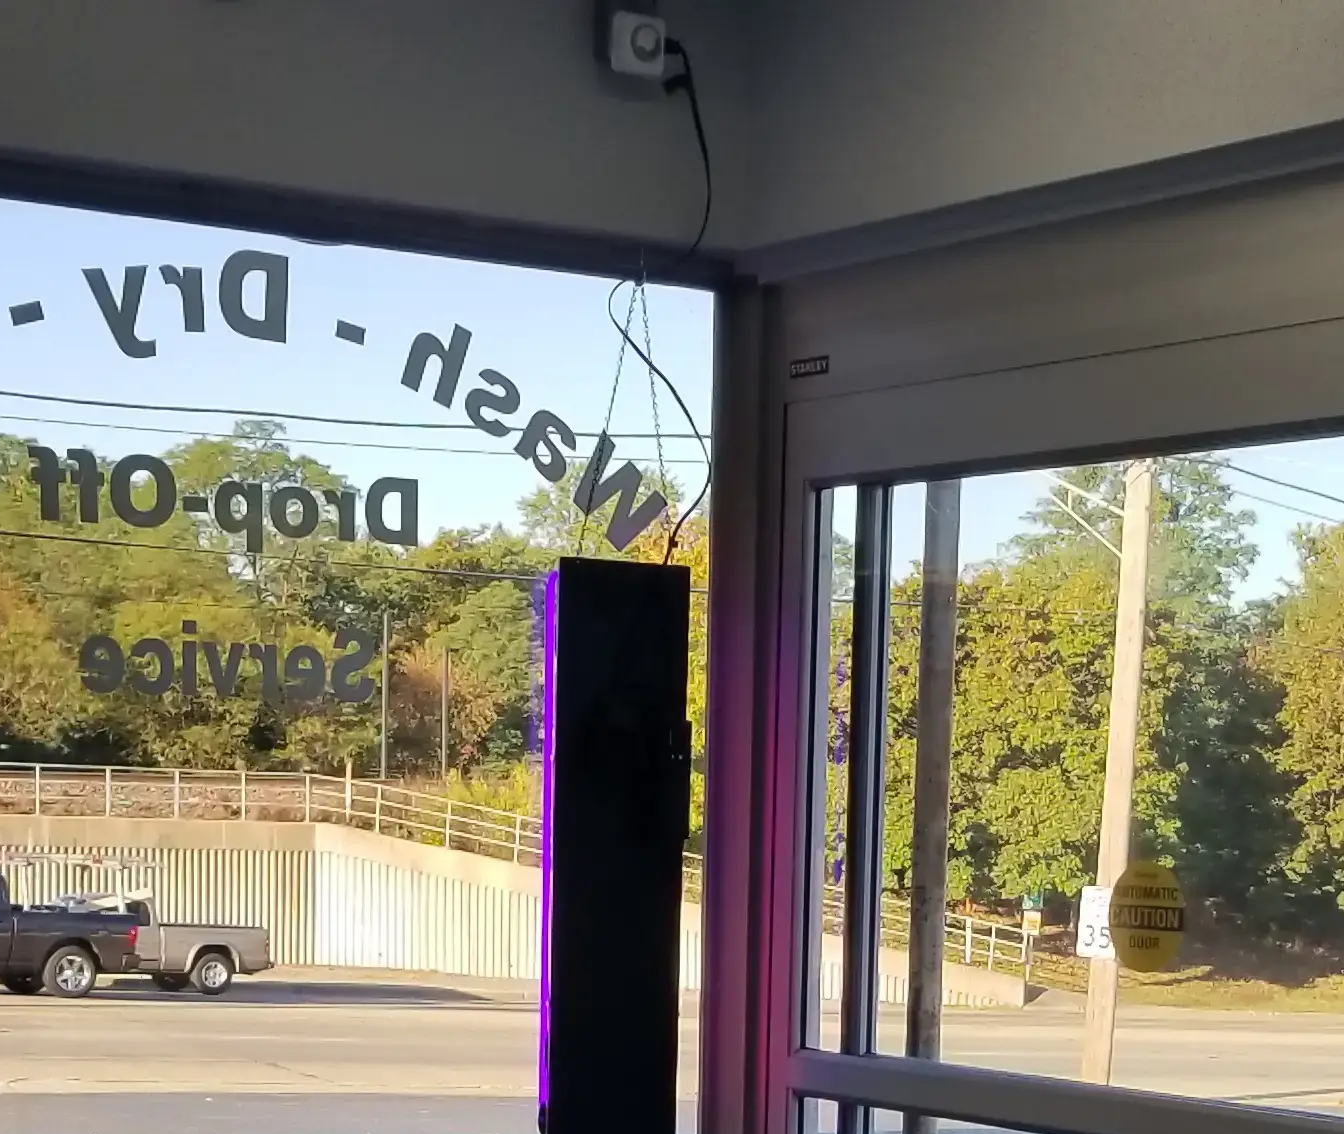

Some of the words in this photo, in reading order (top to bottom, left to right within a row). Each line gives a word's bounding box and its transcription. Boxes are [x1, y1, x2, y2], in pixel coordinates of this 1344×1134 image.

[1110, 906, 1180, 929] CAUTION
[1084, 925, 1112, 948] 35
[1128, 936, 1160, 951] DOOR
